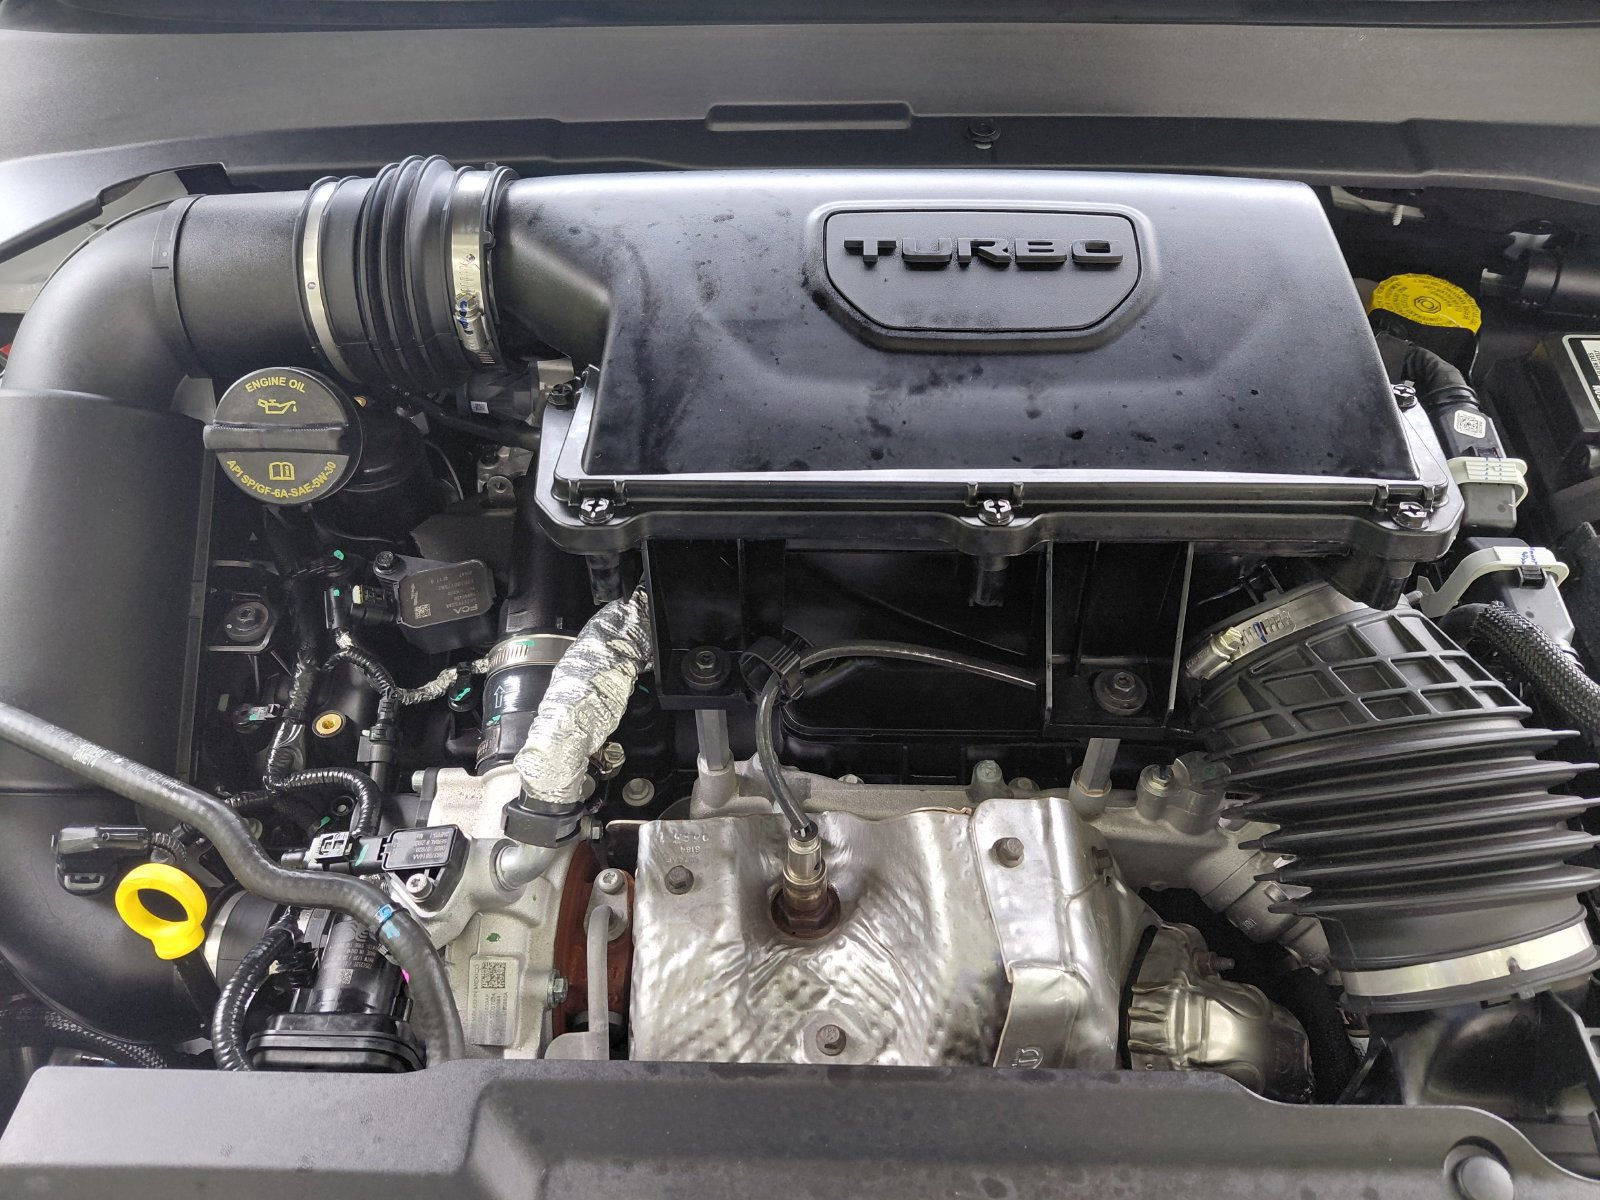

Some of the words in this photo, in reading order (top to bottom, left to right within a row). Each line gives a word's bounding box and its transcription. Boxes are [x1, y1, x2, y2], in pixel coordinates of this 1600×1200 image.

[844, 237, 1124, 266] TURBO
[245, 376, 287, 393] ENGINE
[288, 379, 307, 394] OIL
[227, 459, 244, 478] API
[453, 602, 479, 615] FCA
